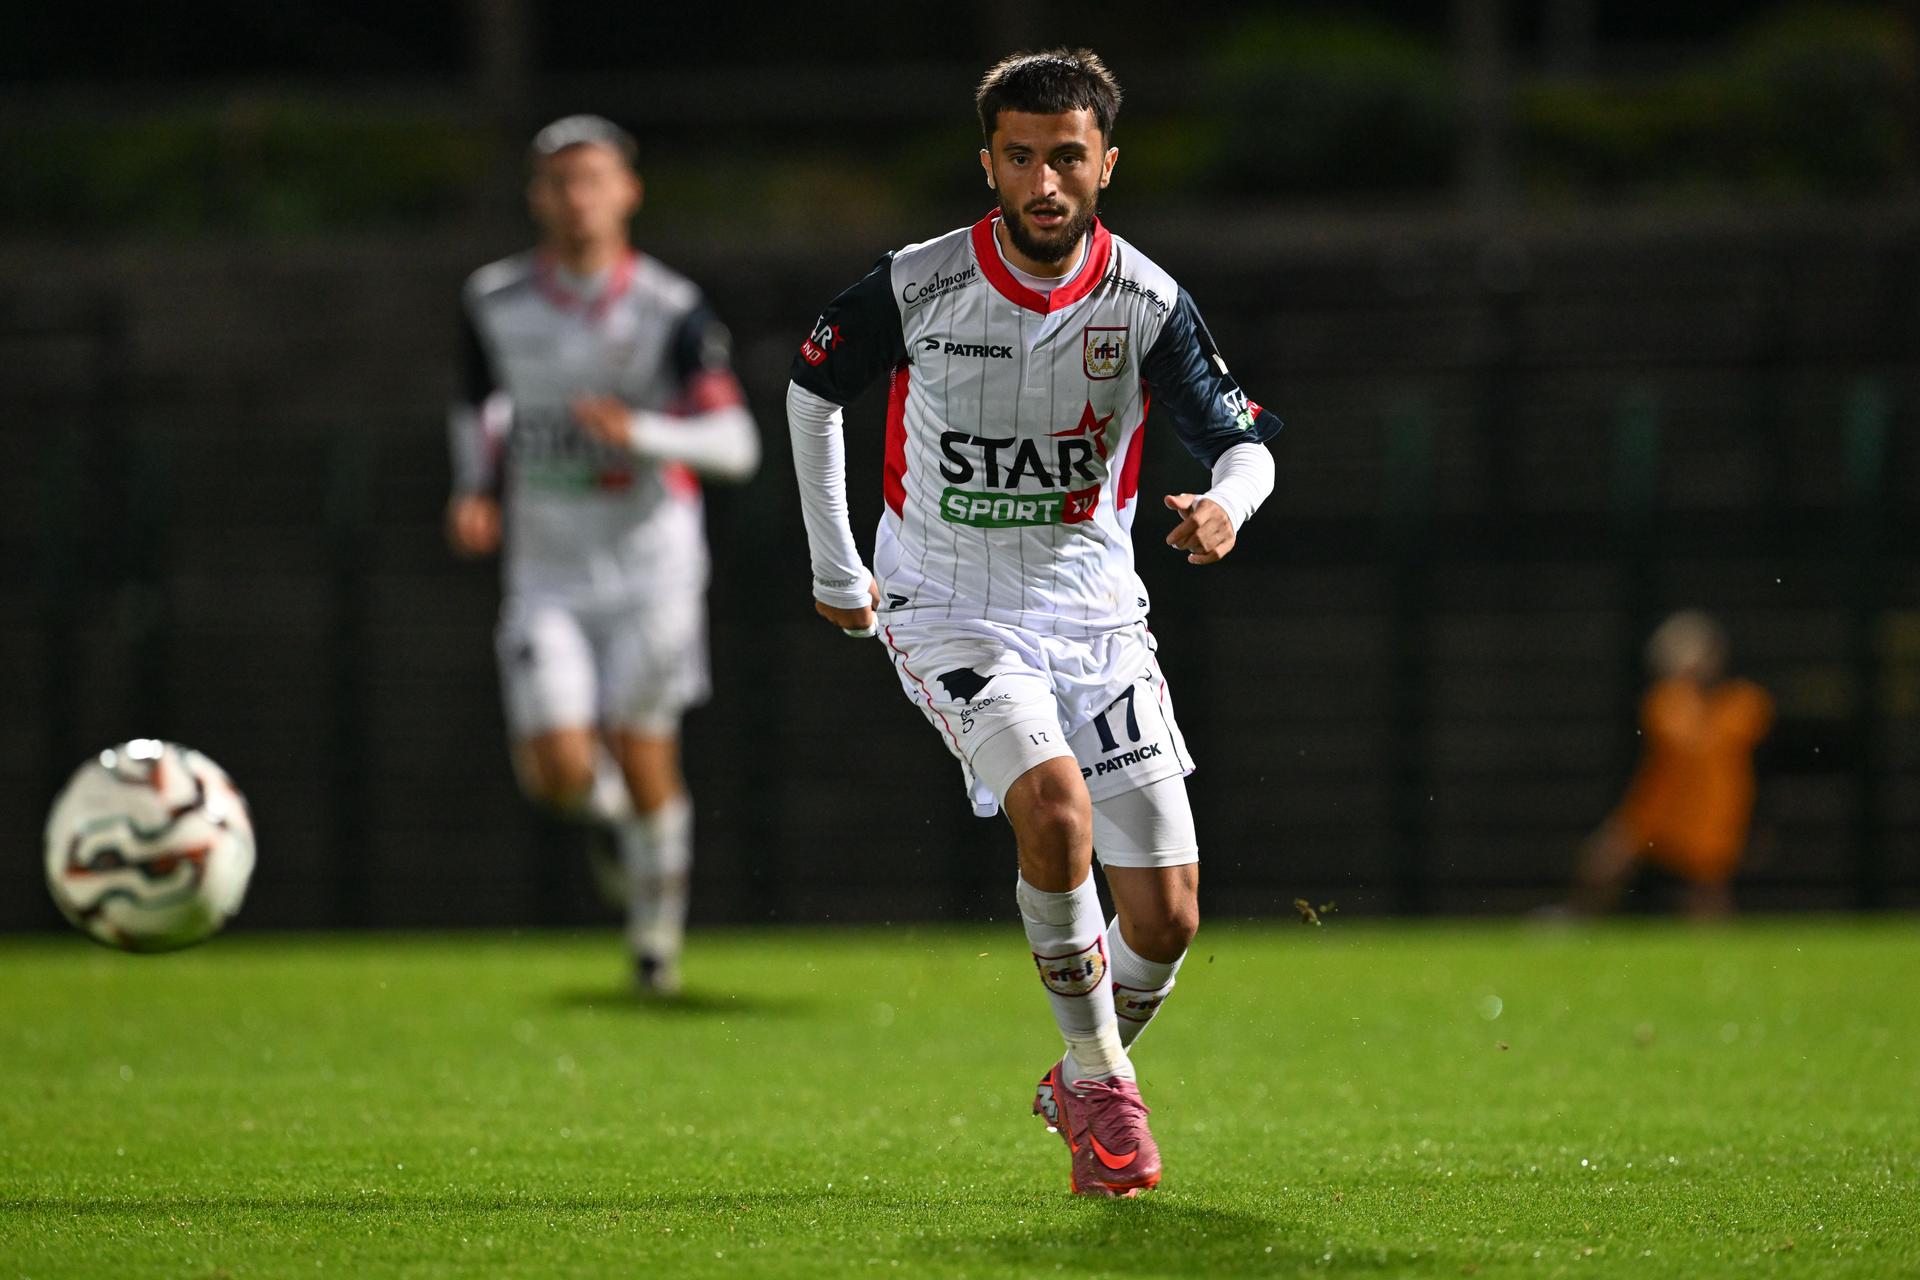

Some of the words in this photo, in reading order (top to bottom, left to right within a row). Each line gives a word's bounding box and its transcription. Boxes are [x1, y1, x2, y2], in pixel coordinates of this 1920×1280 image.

[903, 264, 976, 304] Coelmont
[1144, 289, 1169, 312] SUN
[944, 342, 1013, 359] PATRICK
[939, 431, 1097, 488] STAR
[947, 494, 1059, 522] SPORT
[1093, 684, 1141, 754] 17
[1029, 731, 1050, 745] 17
[1095, 742, 1162, 776] PATRICK
